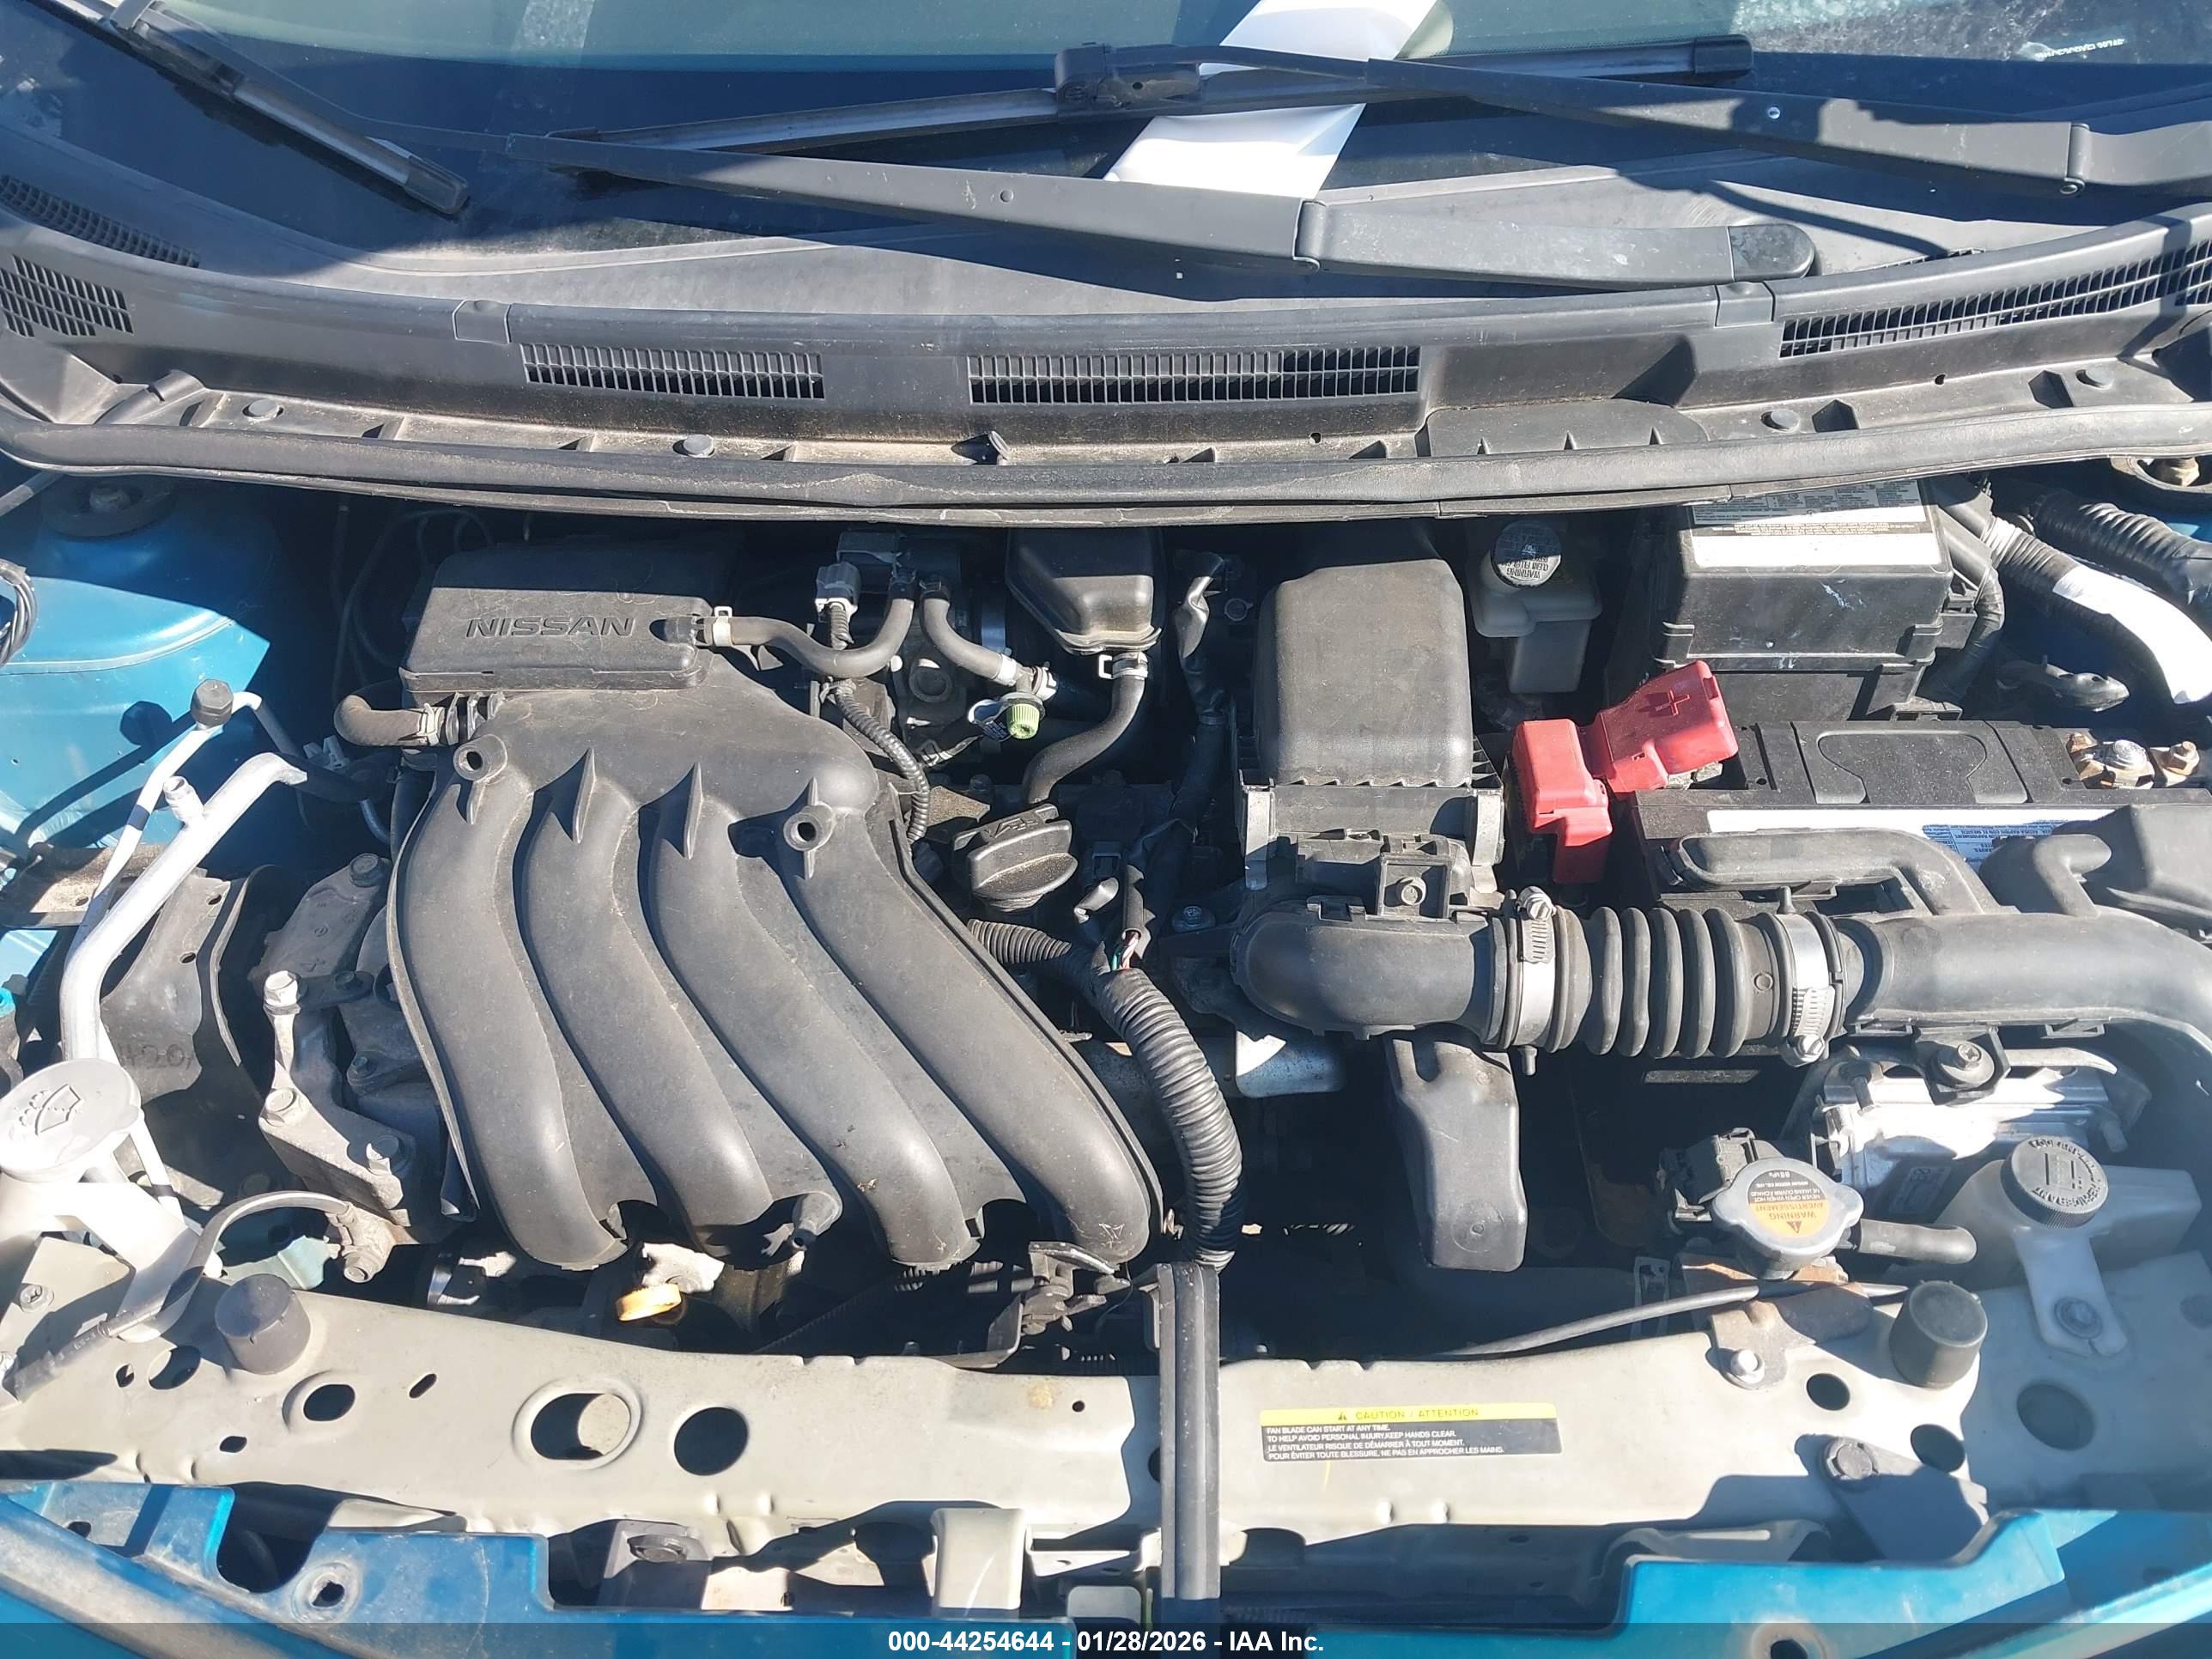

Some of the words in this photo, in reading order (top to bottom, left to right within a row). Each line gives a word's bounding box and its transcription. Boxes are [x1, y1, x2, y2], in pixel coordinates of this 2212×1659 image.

[1507, 568, 1540, 579] WARNING
[465, 616, 635, 638] NISSAN
[1754, 1202, 1824, 1212] AVERTISSEMENT
[1769, 1212, 1817, 1220] WARNING
[1355, 1410, 1405, 1420] CAUTION
[1418, 1407, 1480, 1418] ATTENTION
[1278, 1443, 1324, 1451] VENTILATEUR
[1325, 1442, 1352, 1450] RISQUE
[1364, 1440, 1404, 1449] DÉMARRER
[1291, 1450, 1315, 1460] ÉVITER
[1407, 1448, 1419, 1456] EN
[1419, 1447, 1465, 1455] APPROCHER
